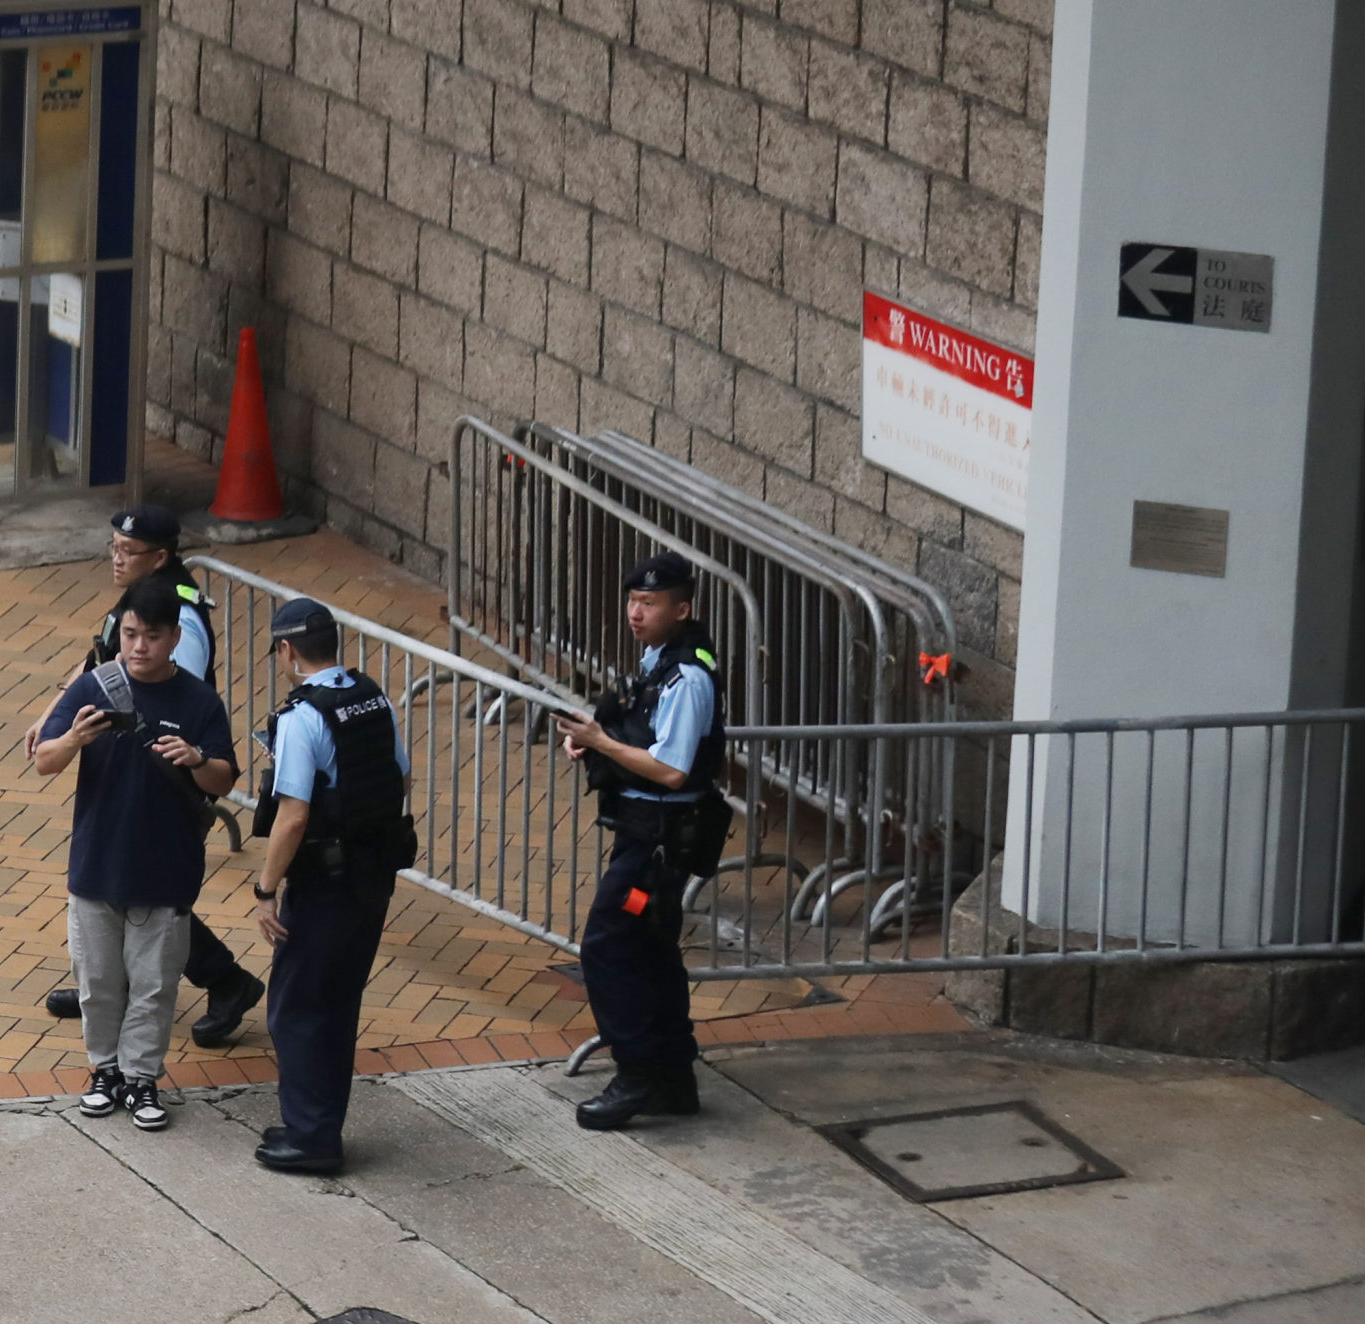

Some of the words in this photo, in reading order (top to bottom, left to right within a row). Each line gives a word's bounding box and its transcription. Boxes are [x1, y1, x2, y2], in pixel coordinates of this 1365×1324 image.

[41, 89, 84, 101] PCCW
[1205, 258, 1227, 273] TO
[1203, 276, 1267, 295] COURTS
[909, 320, 1001, 381] WARNING
[346, 697, 379, 718] POLICE
